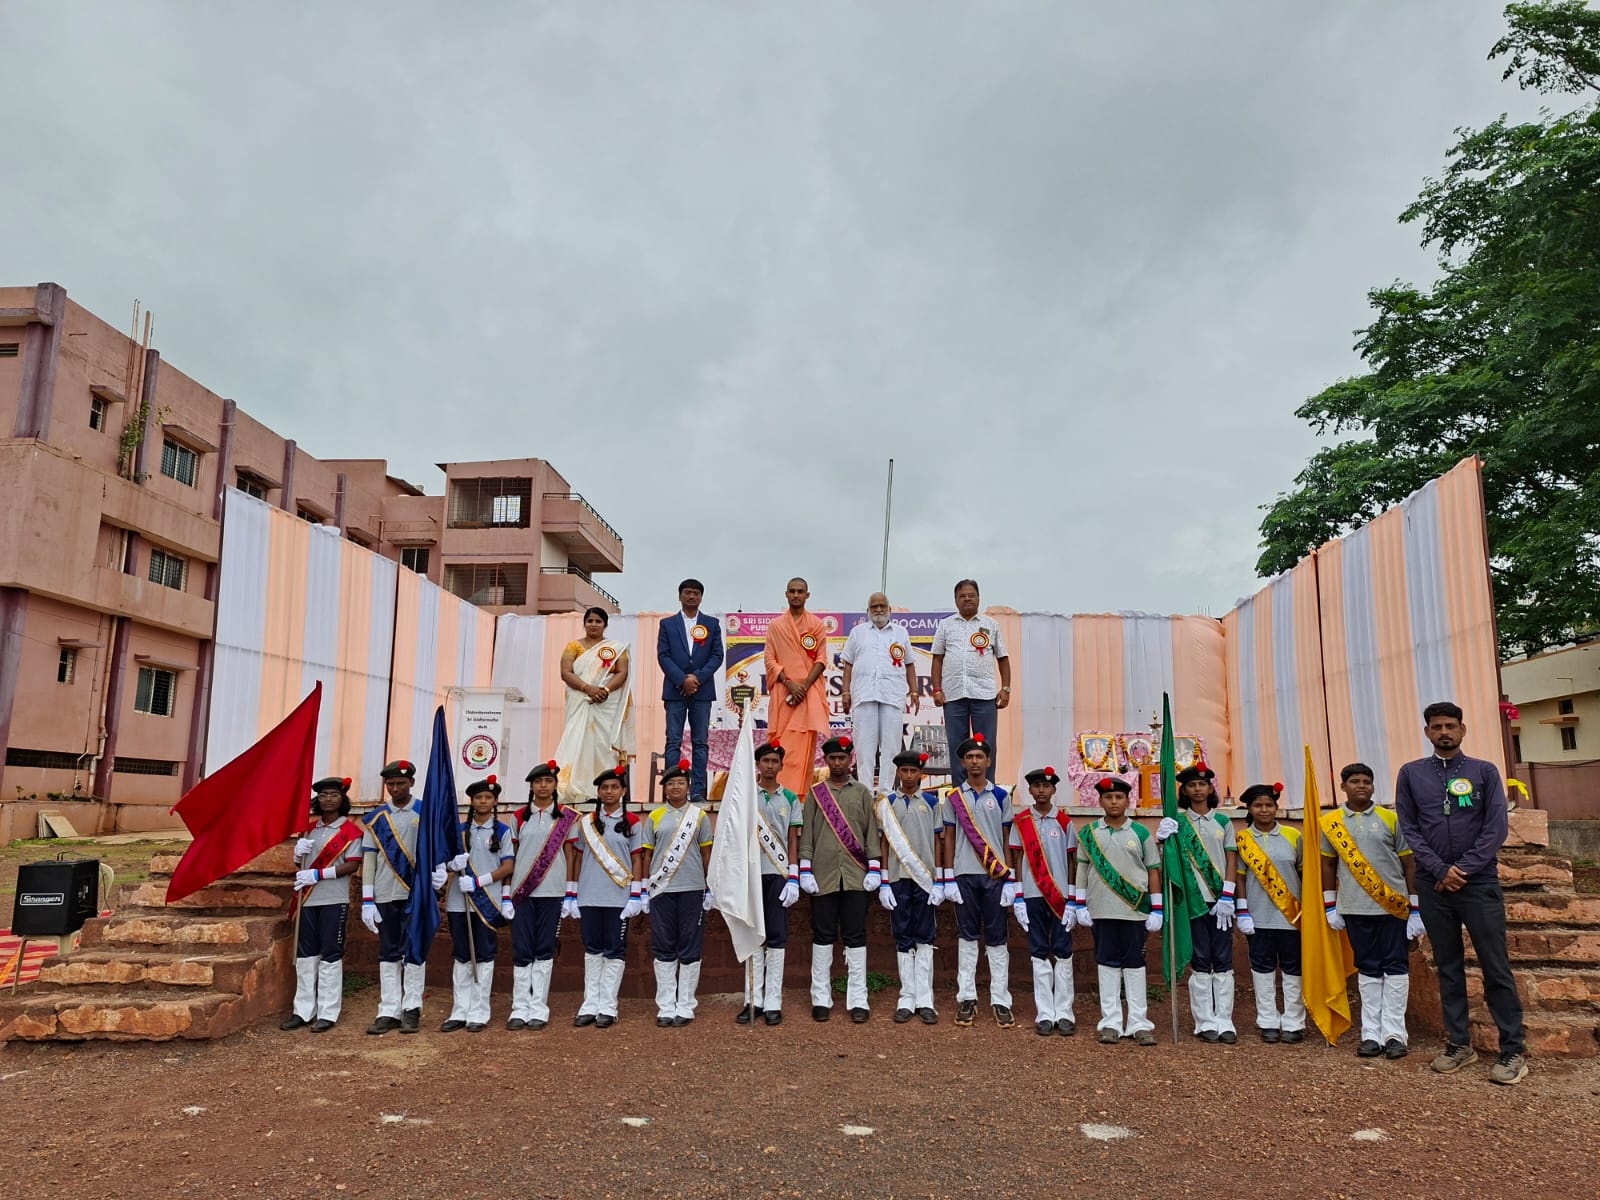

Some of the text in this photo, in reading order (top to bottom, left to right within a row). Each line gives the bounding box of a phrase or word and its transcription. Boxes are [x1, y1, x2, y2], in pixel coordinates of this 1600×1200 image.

[743, 617, 772, 625] SRI SID
[891, 618, 938, 629] ROCAM
